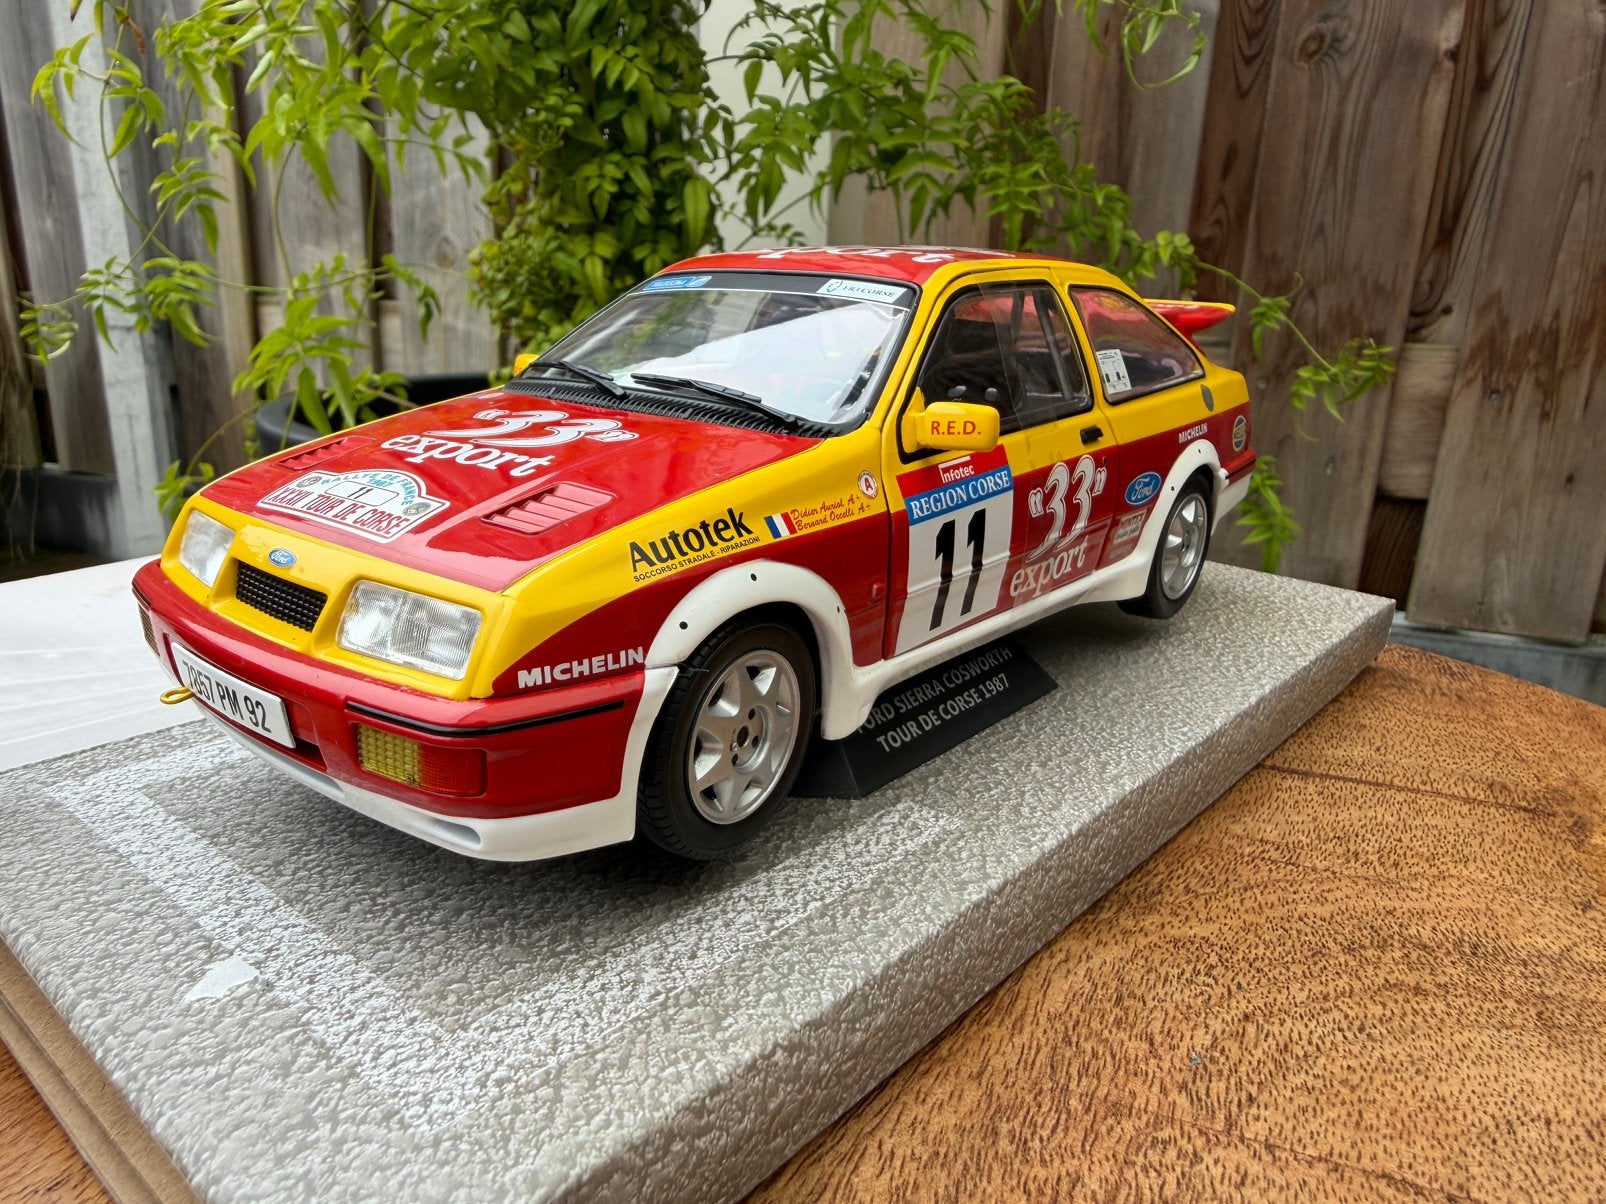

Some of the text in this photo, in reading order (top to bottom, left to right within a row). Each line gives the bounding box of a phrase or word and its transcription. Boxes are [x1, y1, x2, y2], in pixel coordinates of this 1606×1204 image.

[930, 420, 982, 435] R.E.D.
[1178, 423, 1208, 443] MICHELIN
[381, 434, 556, 477] export
[346, 486, 374, 500] 11
[790, 508, 818, 521] Didier
[820, 498, 844, 514] Auriol
[910, 471, 1011, 519] REGION CORSE
[1130, 476, 1159, 501] Ford
[301, 494, 345, 516] TOUR
[332, 503, 366, 521] DE
[352, 508, 411, 535] CORSE
[795, 514, 828, 531] Bernard
[829, 508, 854, 521] Occelli
[629, 508, 754, 573] Autotek
[633, 563, 678, 583] SOCCORSO
[679, 551, 716, 574] STRADALE
[719, 535, 761, 555] RIPARAZIONI
[929, 507, 987, 632] 11
[1009, 536, 1088, 598] export
[517, 646, 644, 689] MICHELIN
[896, 680, 944, 713] SIERRA
[943, 647, 1013, 690] COSWORTH
[182, 660, 272, 734] 7857 PM 92
[876, 673, 1010, 753] TOUR DE CORSE 1987
